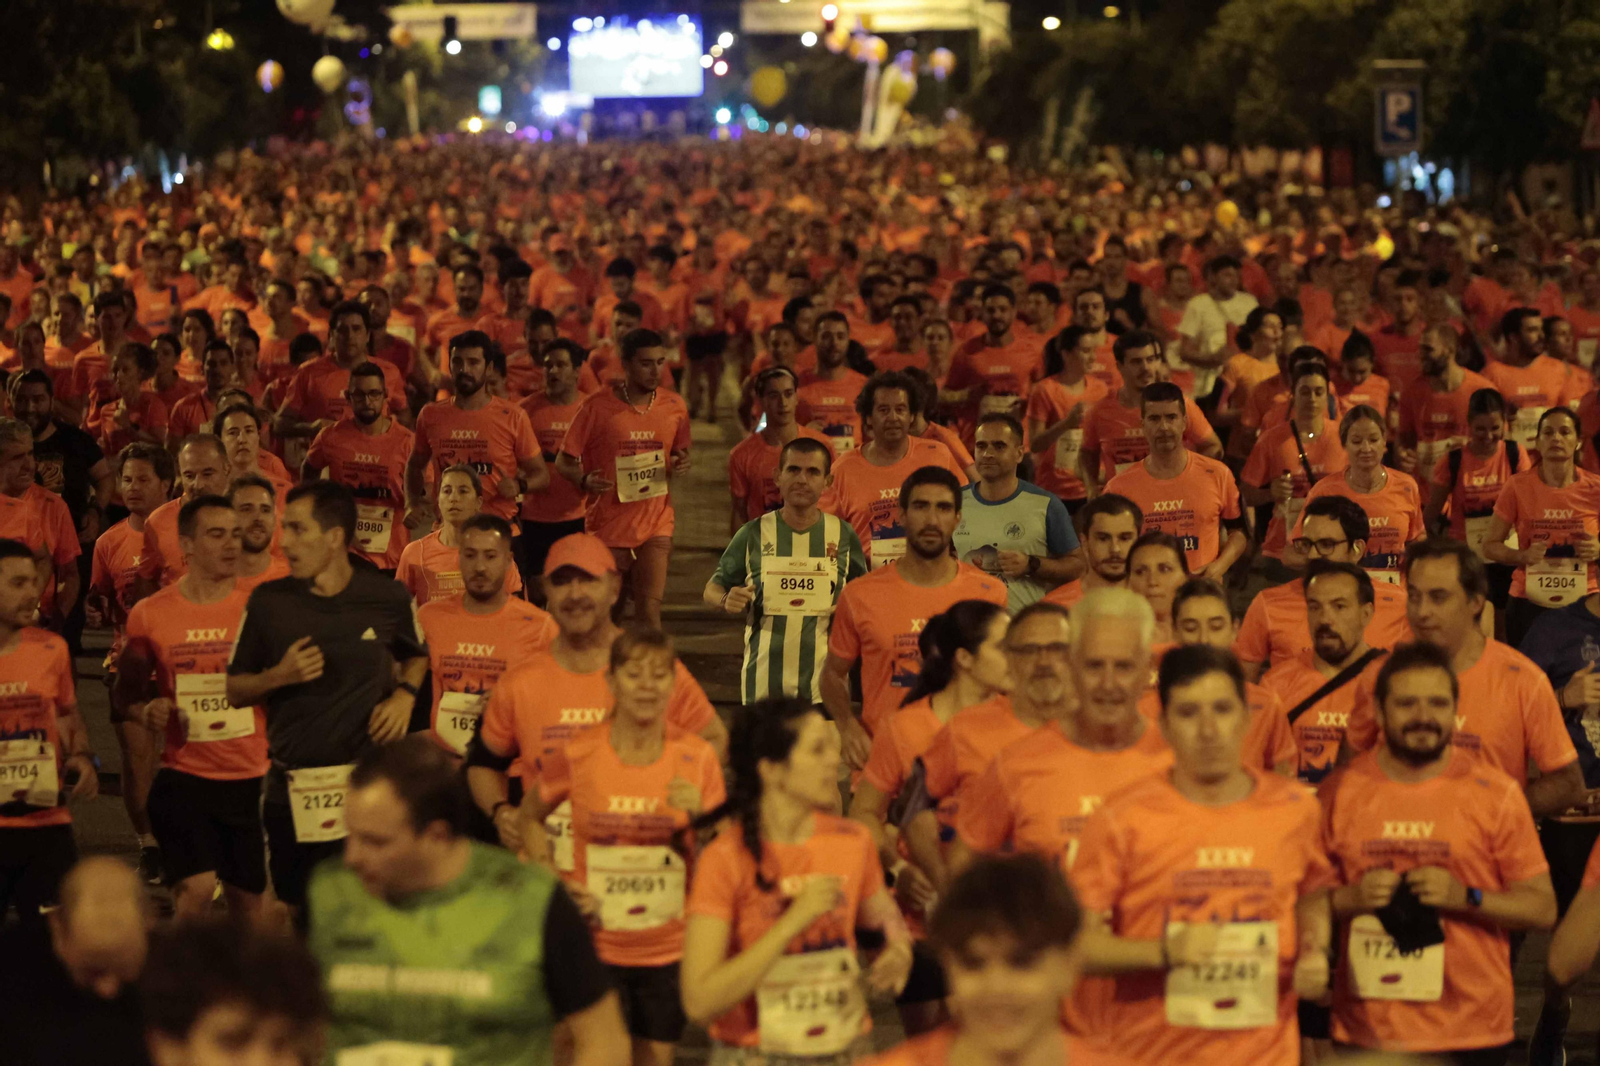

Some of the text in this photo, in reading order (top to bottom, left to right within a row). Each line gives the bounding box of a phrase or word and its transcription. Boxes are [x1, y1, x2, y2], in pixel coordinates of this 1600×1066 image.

[451, 430, 480, 439] XXXV
[630, 431, 655, 440] XXXV
[354, 453, 380, 463] XXXV
[628, 468, 657, 481] 11027
[1153, 500, 1184, 511] XXXV
[1544, 508, 1574, 519] XXXV
[357, 520, 384, 533] 8980
[780, 578, 815, 590] 8948
[1538, 577, 1576, 588] 12904
[186, 628, 228, 642] XXXV
[456, 642, 496, 656] XXXV
[192, 698, 230, 712] 1630
[559, 708, 606, 724] XXXV
[303, 792, 344, 810] 2122
[608, 795, 659, 812] XXXV
[1382, 821, 1435, 839] XXXV
[1197, 847, 1255, 869] XXXV
[605, 876, 666, 894] 20691
